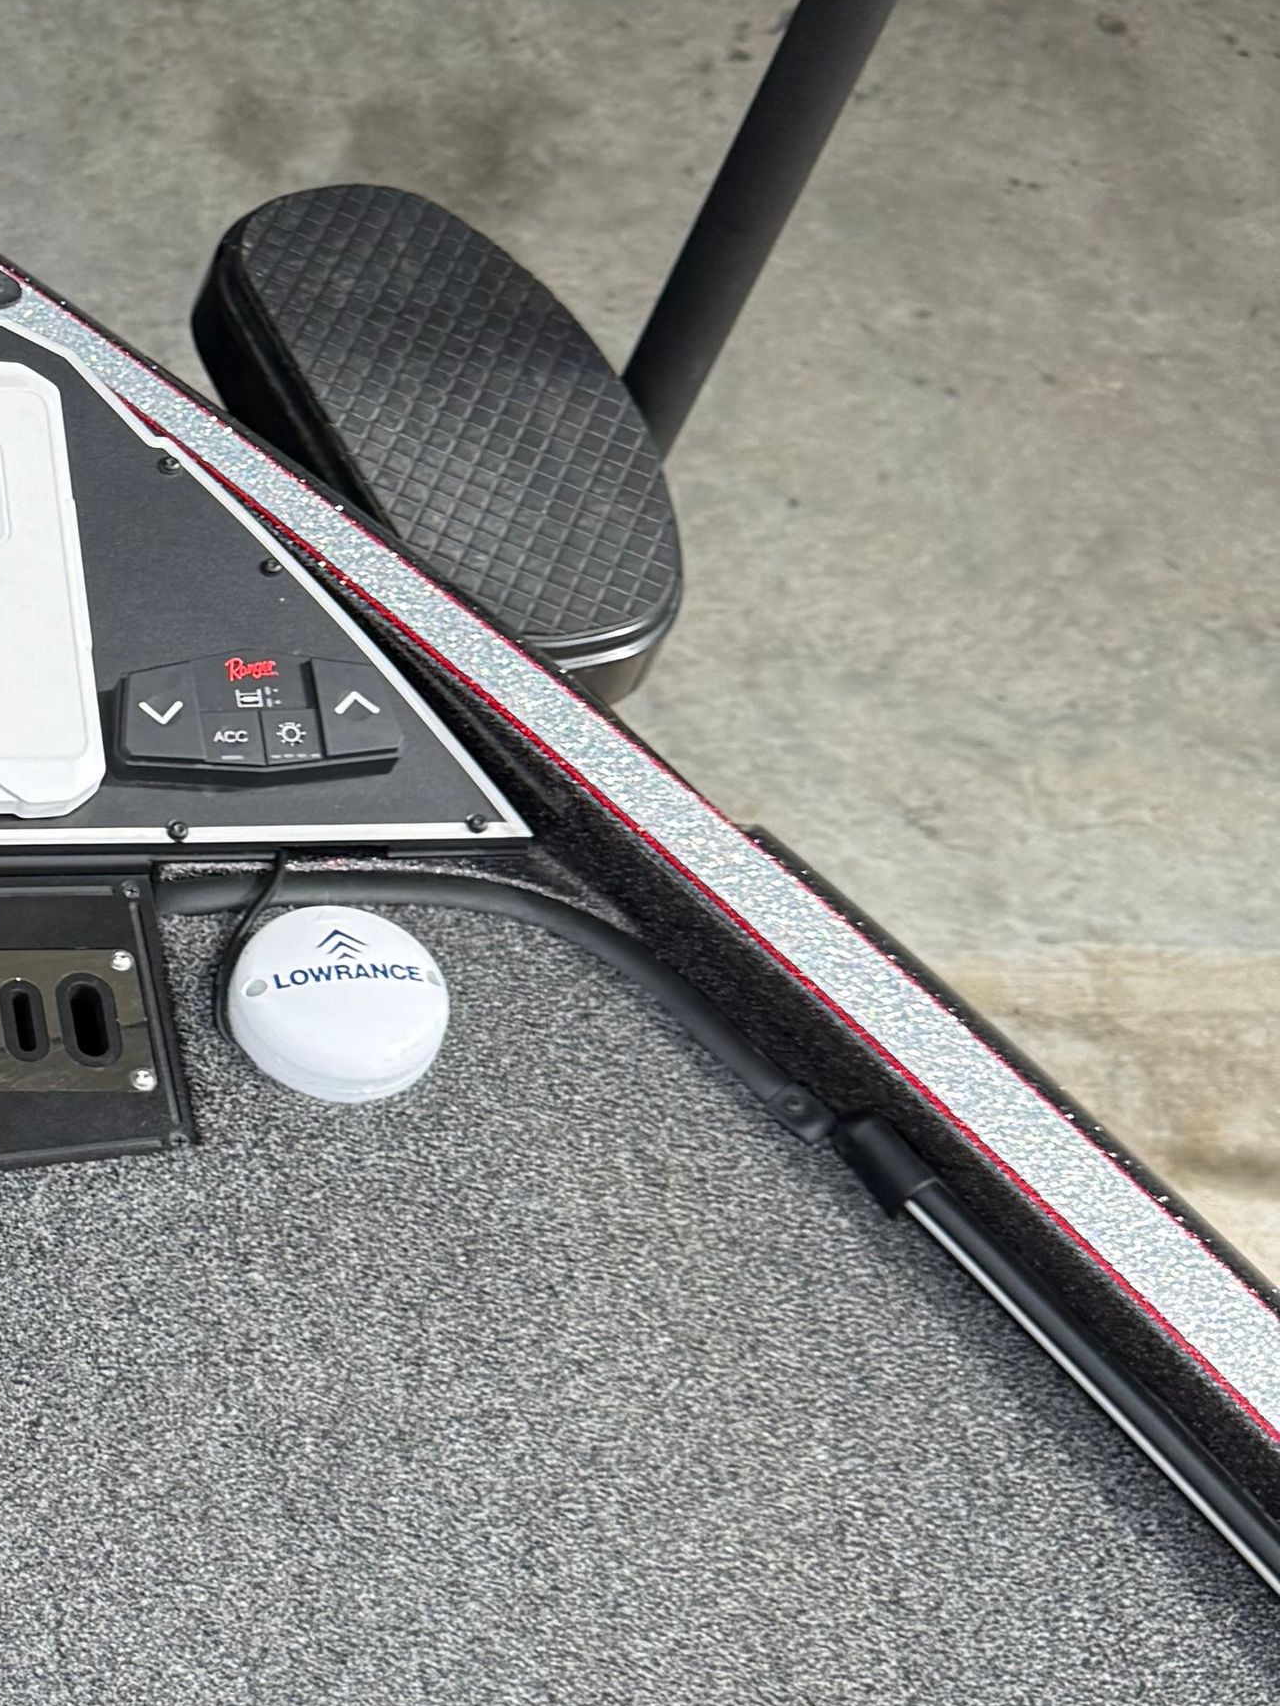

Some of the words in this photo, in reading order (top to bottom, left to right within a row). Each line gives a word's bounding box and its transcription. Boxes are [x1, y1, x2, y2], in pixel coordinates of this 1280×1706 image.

[225, 657, 279, 681] Ranger
[213, 728, 249, 744] ACC
[272, 963, 424, 991] LOWRANCE
